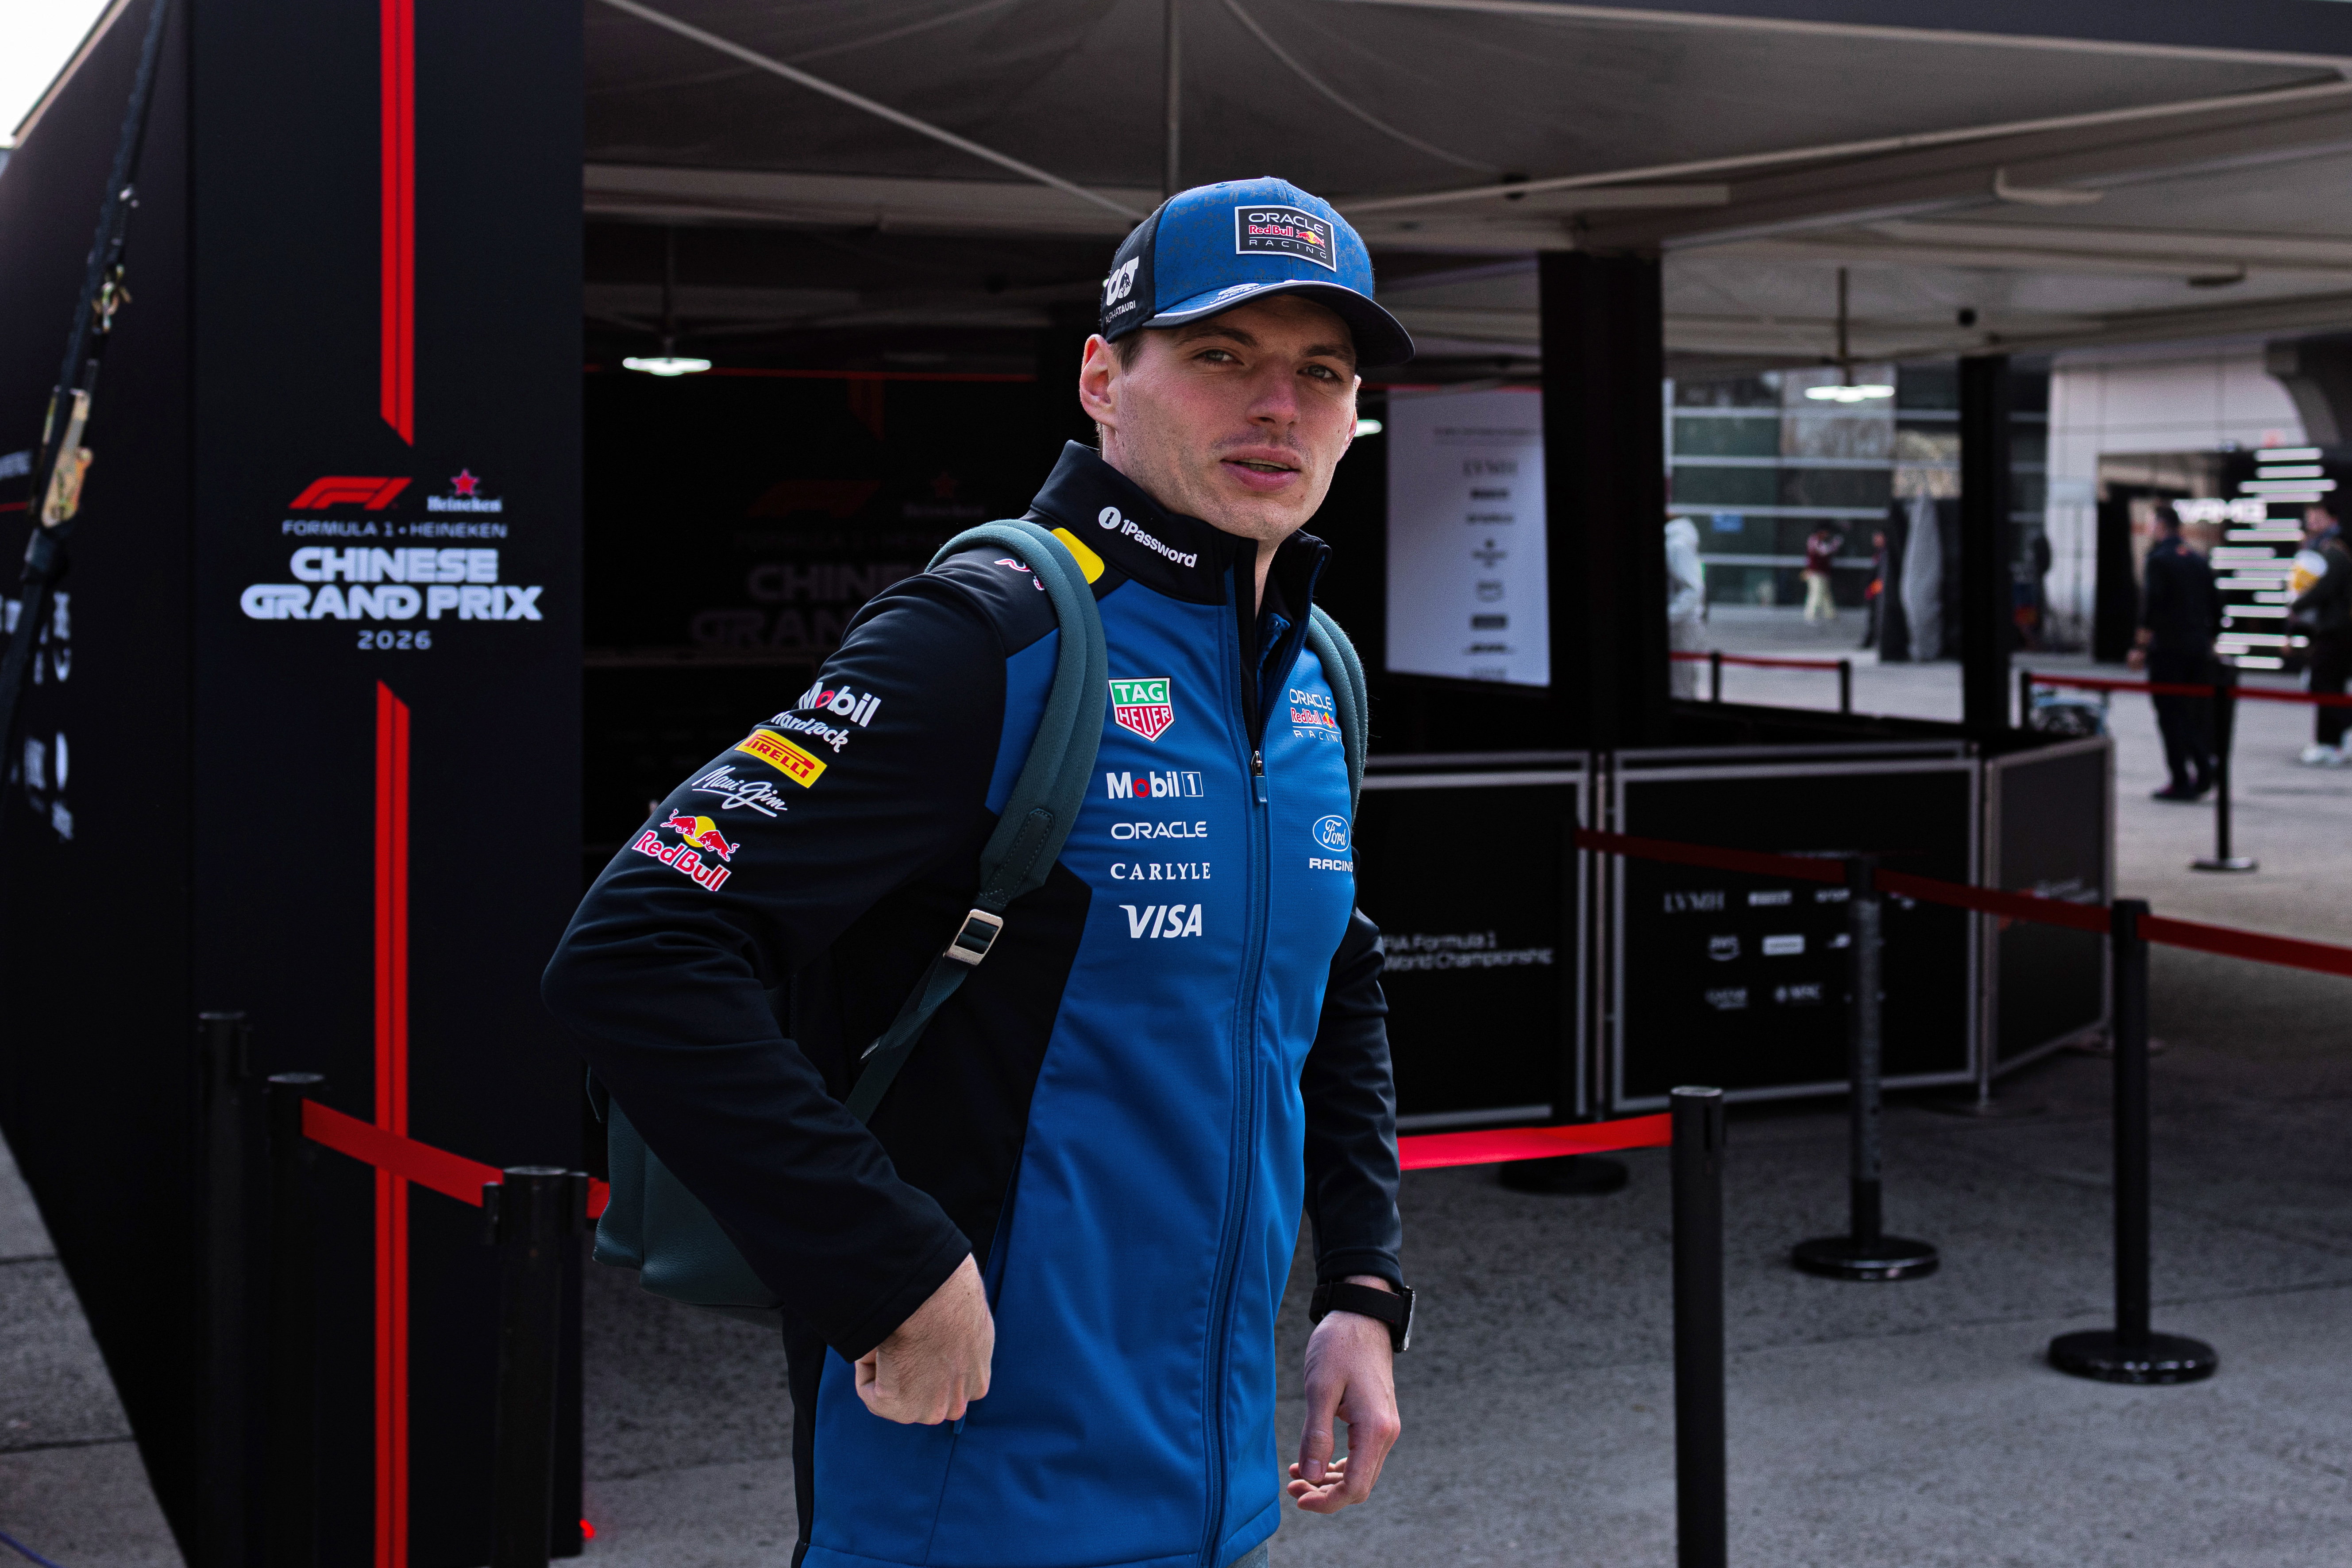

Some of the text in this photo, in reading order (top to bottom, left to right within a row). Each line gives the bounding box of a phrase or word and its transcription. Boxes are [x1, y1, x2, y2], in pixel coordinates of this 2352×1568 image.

[1248, 212, 1324, 235] ORACLE
[1249, 239, 1326, 259] RACING
[1106, 300, 1136, 325] ALPHATAURI
[282, 520, 508, 539] FORMULA 1 HEINEKEN
[1121, 519, 1197, 568] 1Password
[290, 546, 498, 583] CHINESE
[240, 584, 544, 620] GRAND PRIX
[357, 630, 432, 650] 2026
[799, 682, 881, 727] Mobil
[1114, 683, 1164, 702] TAG
[1289, 688, 1332, 711] ORACLE
[1118, 707, 1170, 736] HEUER
[744, 734, 815, 779] PIRELLI
[691, 765, 788, 809] Maui Jim
[1107, 771, 1180, 799] Mobil
[1111, 821, 1207, 840] ORACLE
[1323, 819, 1346, 846] Ford
[1110, 862, 1211, 880] CARLYLE
[1118, 904, 1203, 939] VISA
